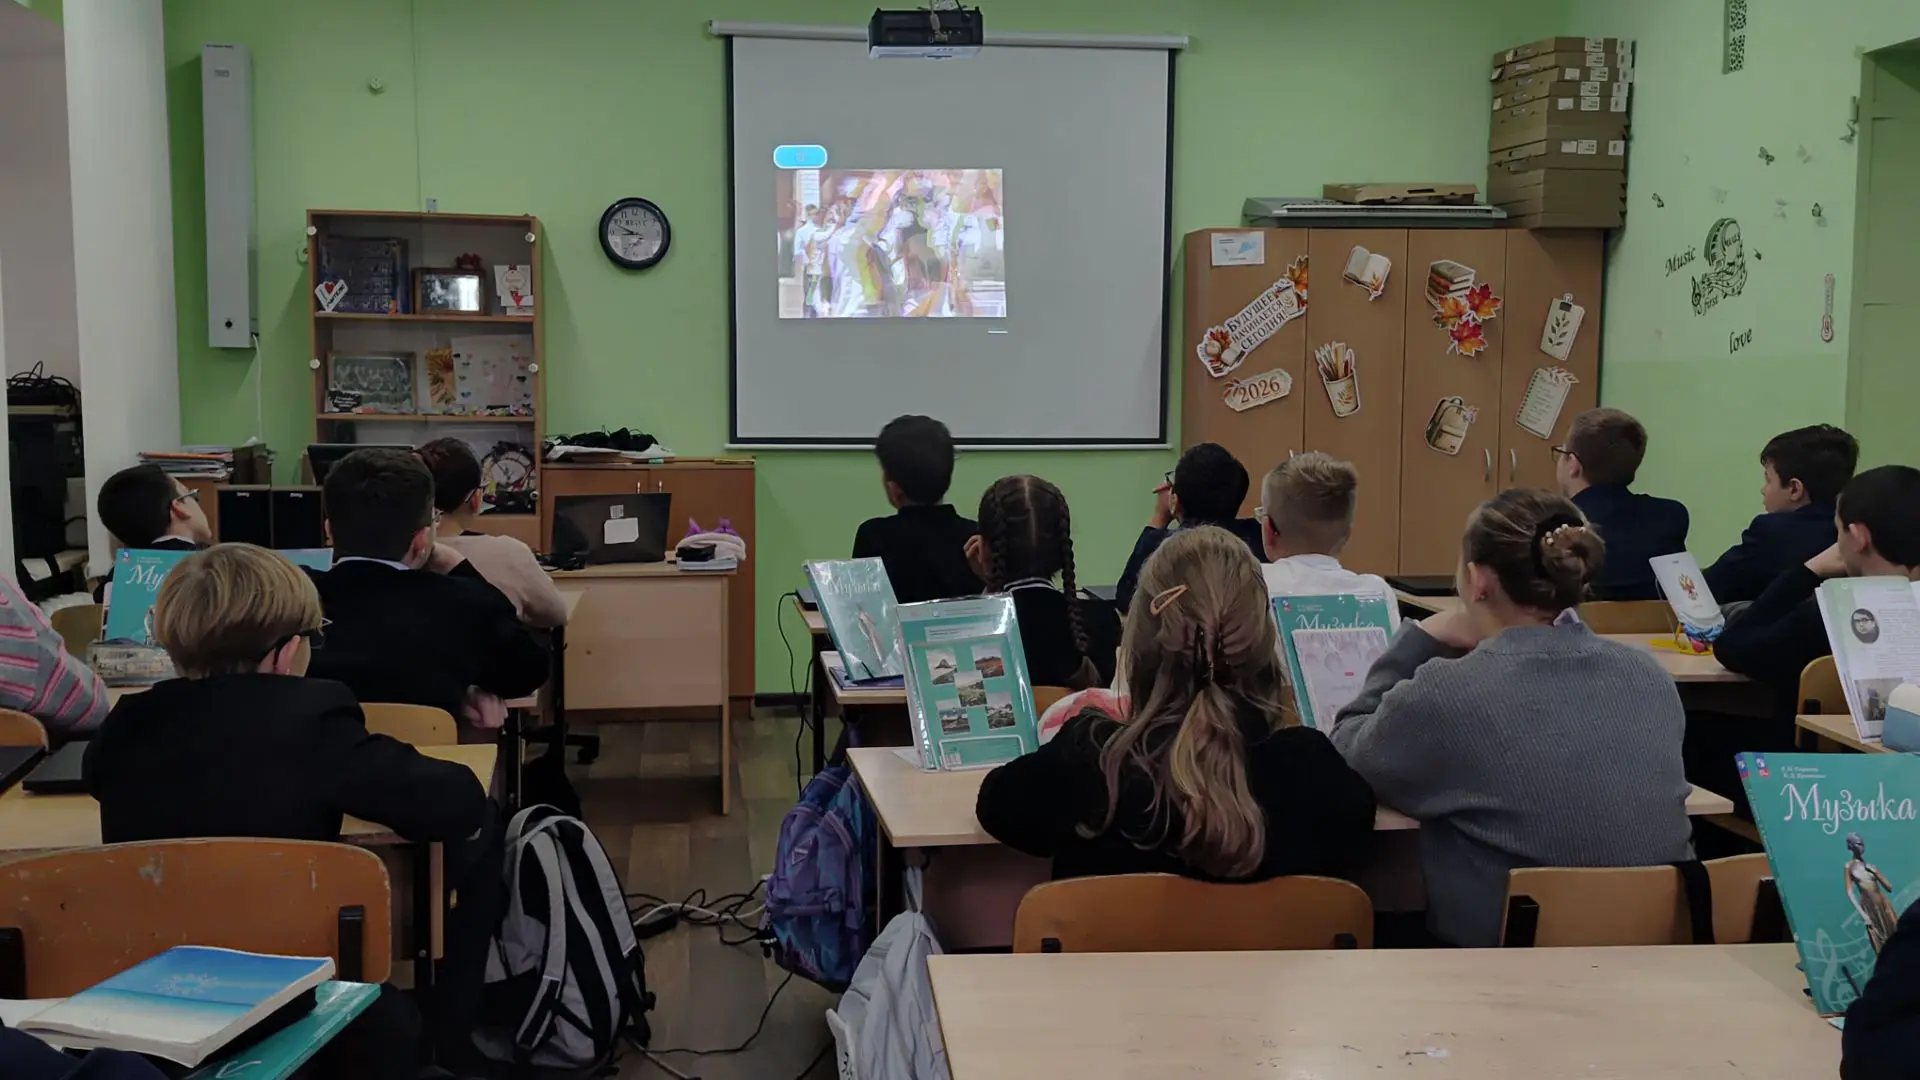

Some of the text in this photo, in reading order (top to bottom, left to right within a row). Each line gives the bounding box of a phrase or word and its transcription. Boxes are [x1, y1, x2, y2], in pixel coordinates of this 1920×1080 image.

[621, 210, 627, 219] 11
[1665, 245, 1696, 278] Music
[1227, 291, 1275, 332] БУДУЩЕЕ
[1231, 299, 1284, 344] НАЧИНАЕТСЯ
[1240, 309, 1289, 350] СЕГОДНЯ!
[1729, 328, 1753, 354] love
[1239, 376, 1281, 404] 2026
[1780, 781, 1917, 835] Музыка
